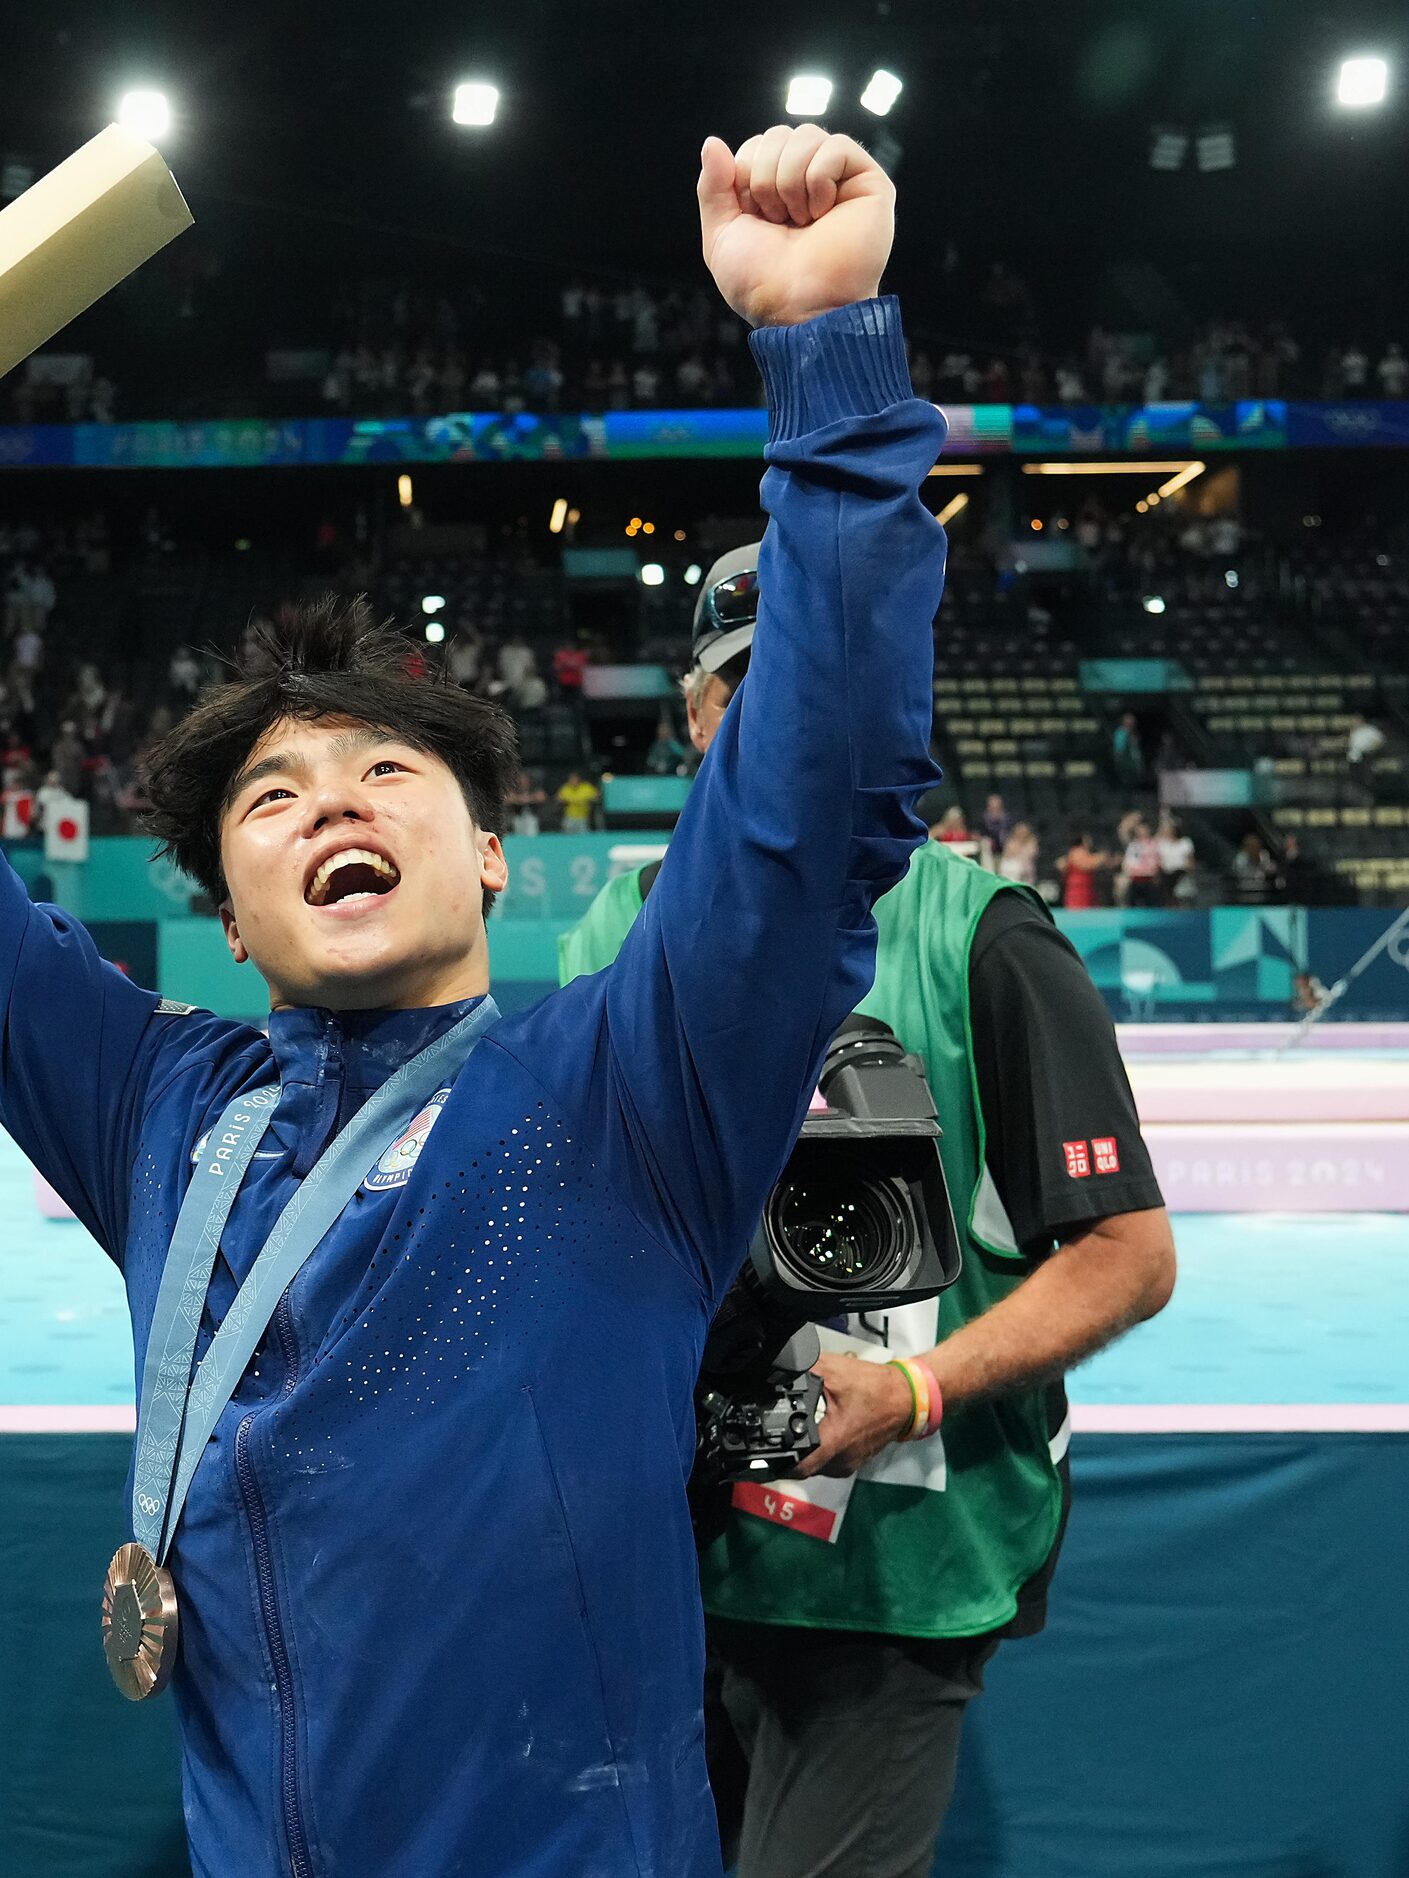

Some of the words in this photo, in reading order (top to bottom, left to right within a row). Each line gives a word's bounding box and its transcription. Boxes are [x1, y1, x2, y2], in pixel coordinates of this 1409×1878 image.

[1167, 1159, 1274, 1187] PARIS
[1287, 1159, 1385, 1187] 2024
[764, 1494, 795, 1521] 45
